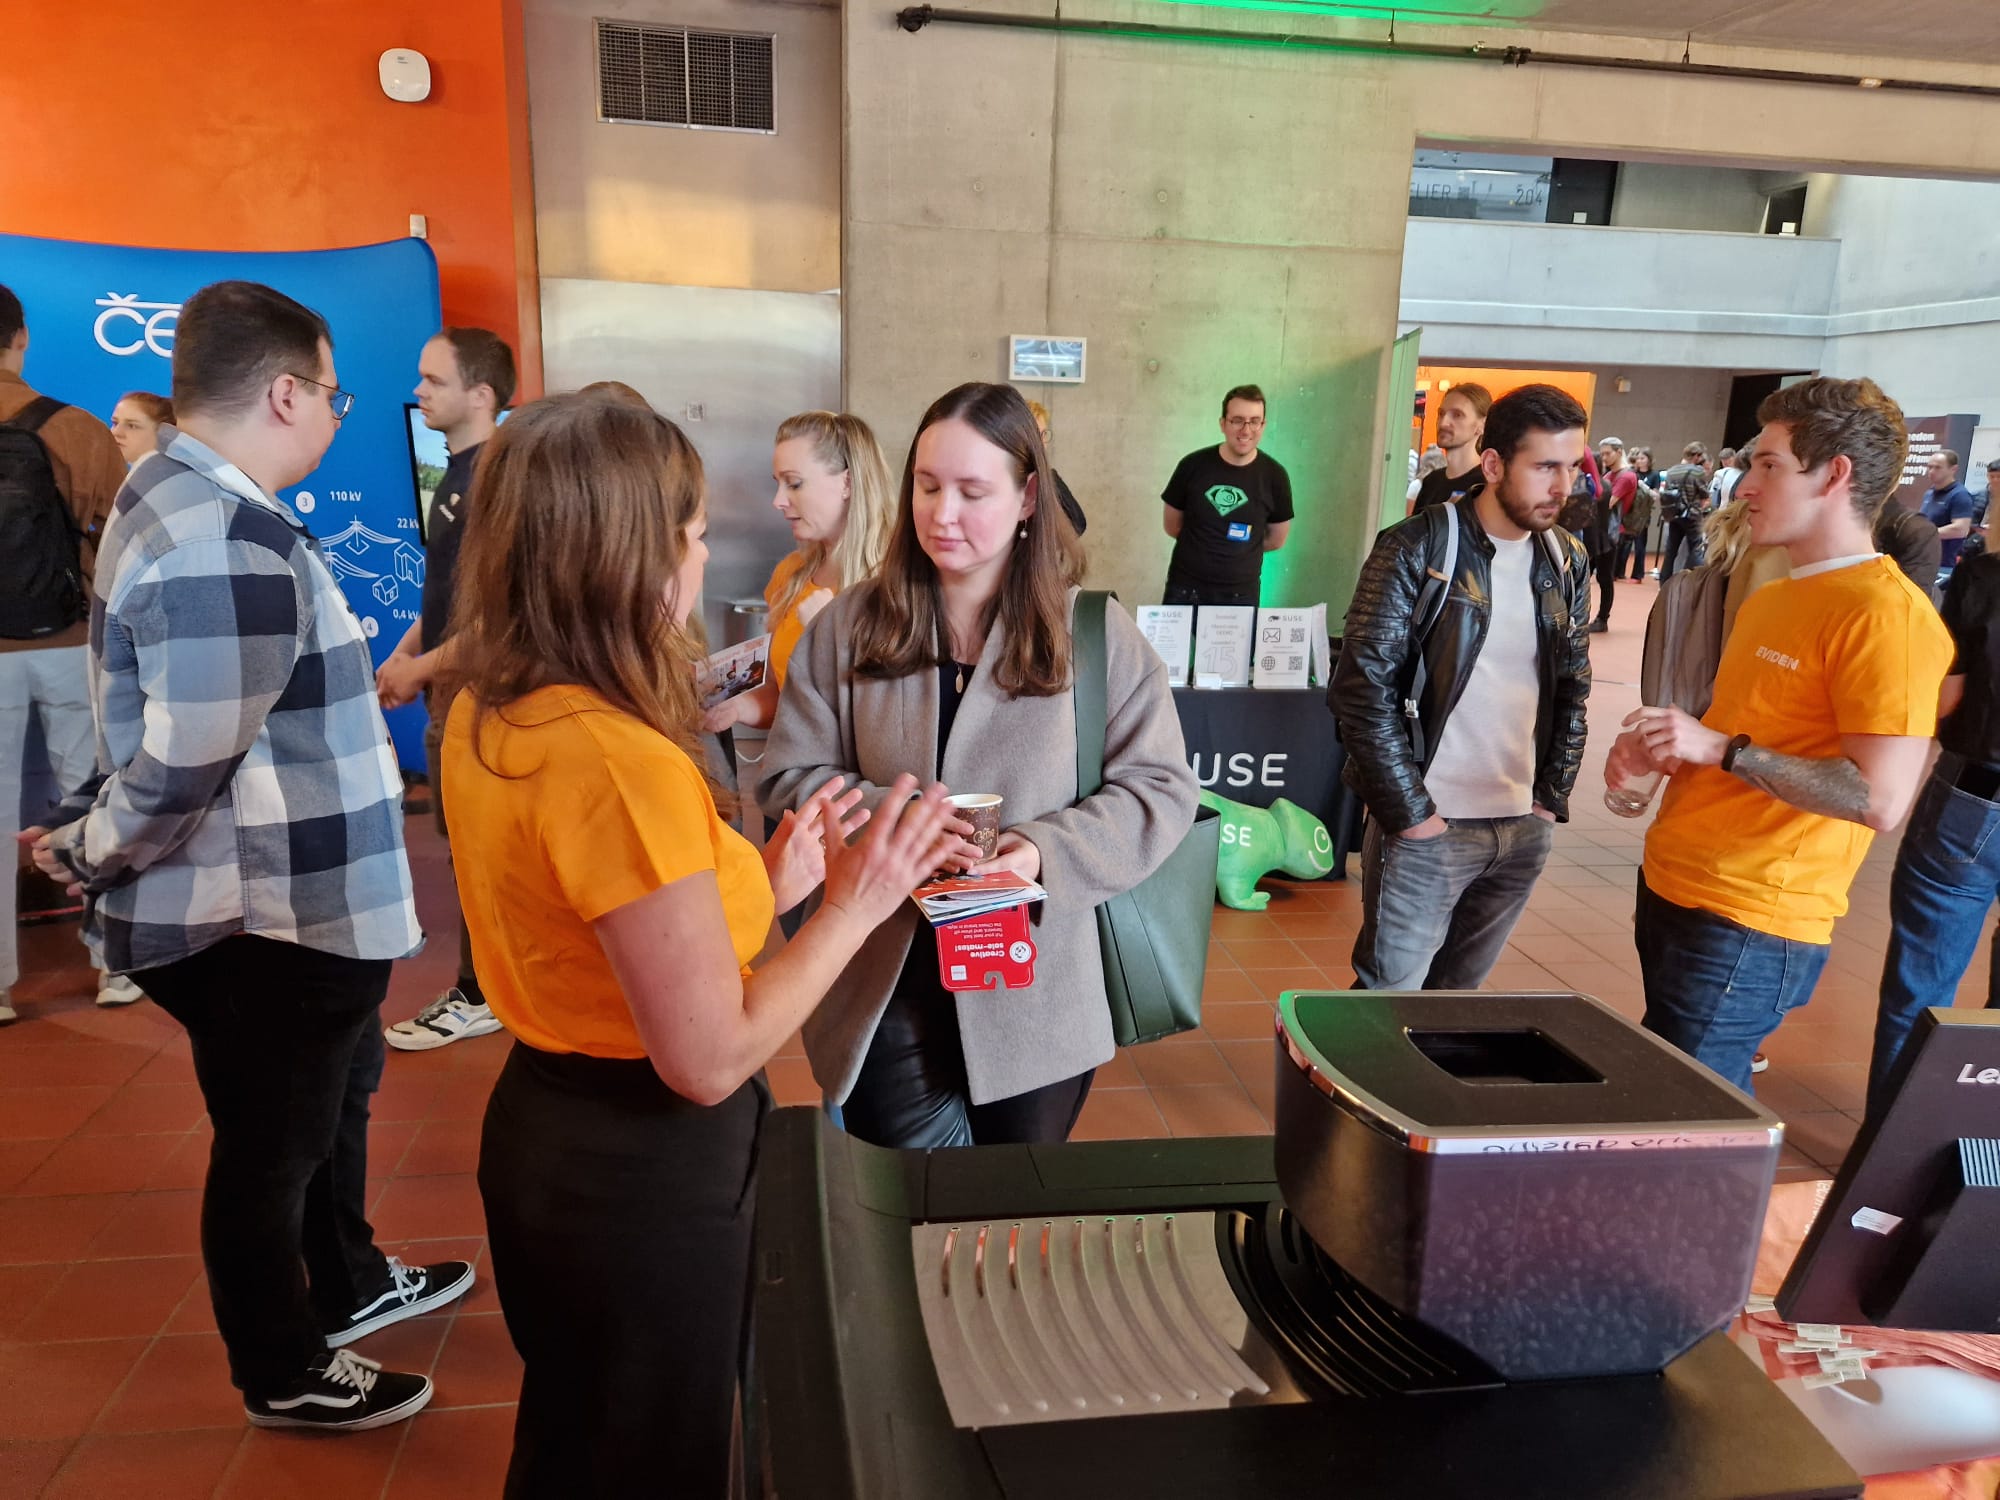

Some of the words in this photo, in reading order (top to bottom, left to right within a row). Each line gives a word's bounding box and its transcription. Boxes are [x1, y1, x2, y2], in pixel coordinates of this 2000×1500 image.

[329, 491, 349, 502] 110
[349, 491, 362, 502] kV
[302, 498, 309, 507] 3
[397, 518, 408, 528] 22
[392, 608, 406, 620] 0,4
[366, 621, 374, 632] 4
[1755, 645, 1800, 671] EVIDEN
[1221, 824, 1253, 847] SE
[954, 943, 1004, 953] sole-mates!
[969, 950, 1005, 959] Creative
[1956, 1063, 2000, 1085] Le
